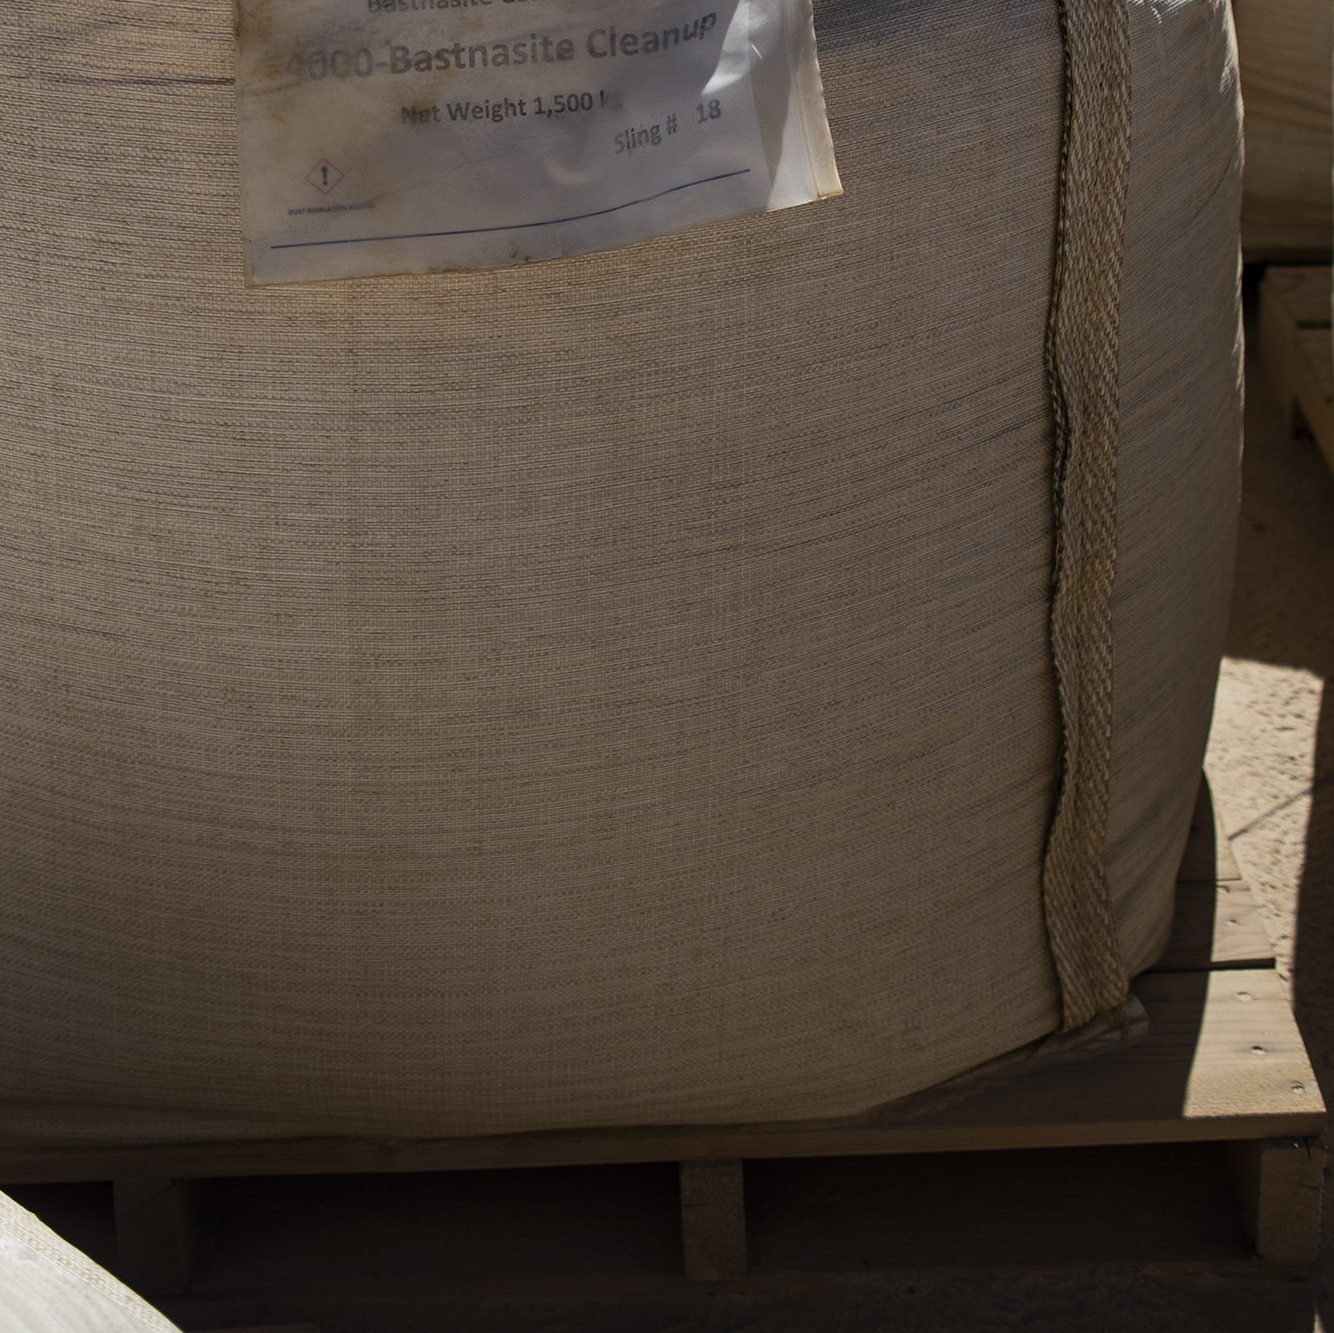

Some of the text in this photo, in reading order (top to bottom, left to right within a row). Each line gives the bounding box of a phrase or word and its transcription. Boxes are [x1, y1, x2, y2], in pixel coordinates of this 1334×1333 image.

[586, 11, 717, 59] Cleanup
[401, 105, 440, 124] Net
[446, 97, 527, 123] Weight
[533, 91, 593, 118] 1,500
[614, 99, 722, 154] Sling # 18
